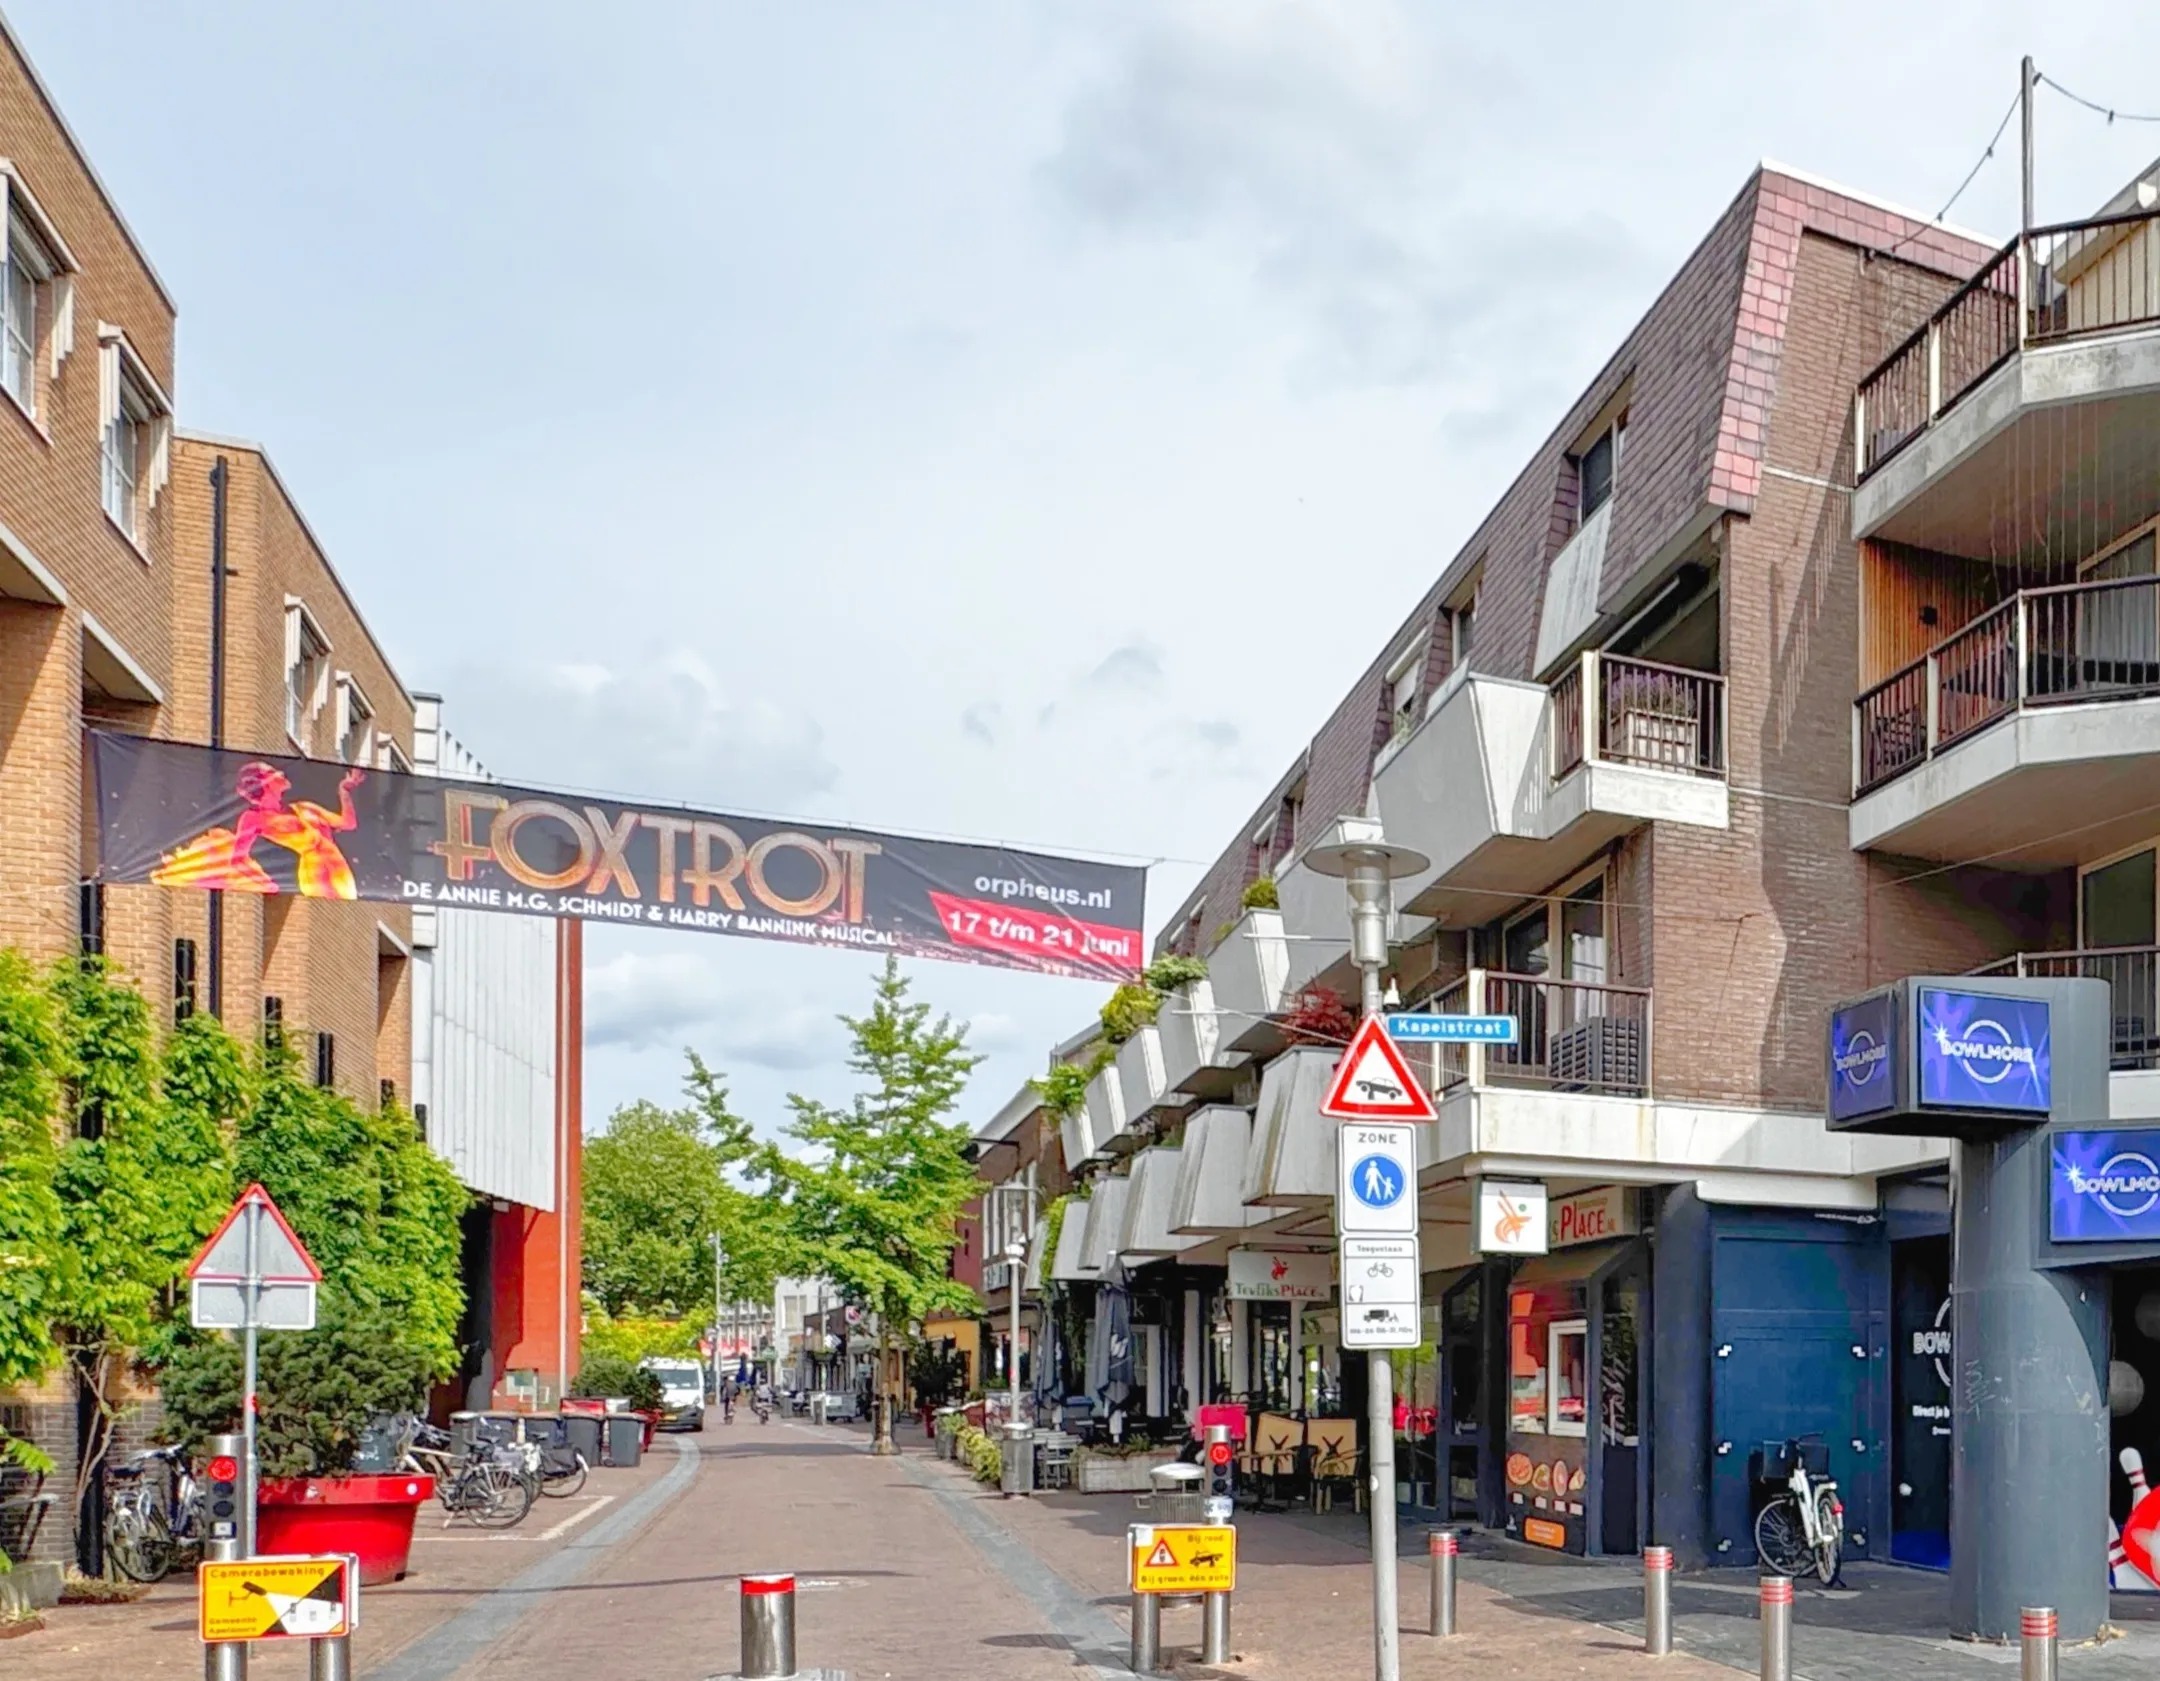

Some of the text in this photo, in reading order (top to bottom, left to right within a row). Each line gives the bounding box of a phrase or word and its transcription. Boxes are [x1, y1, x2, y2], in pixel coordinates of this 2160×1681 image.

[428, 788, 883, 925] FOXTROT
[974, 876, 1112, 909] orpheus.nl
[402, 880, 898, 947] DE ANNIE M.G. SCHMIDT & HARRY BANNINK MUSICAL
[948, 911, 1131, 957] 17 t/m 21 juni
[1397, 1019, 1502, 1037] Kapelstraat
[1940, 1040, 2034, 1064] BOWLMORE
[1357, 1132, 1398, 1146] ZONE
[1912, 1331, 1952, 1355] BOW
[210, 1566, 325, 1579] Camerabewaking
